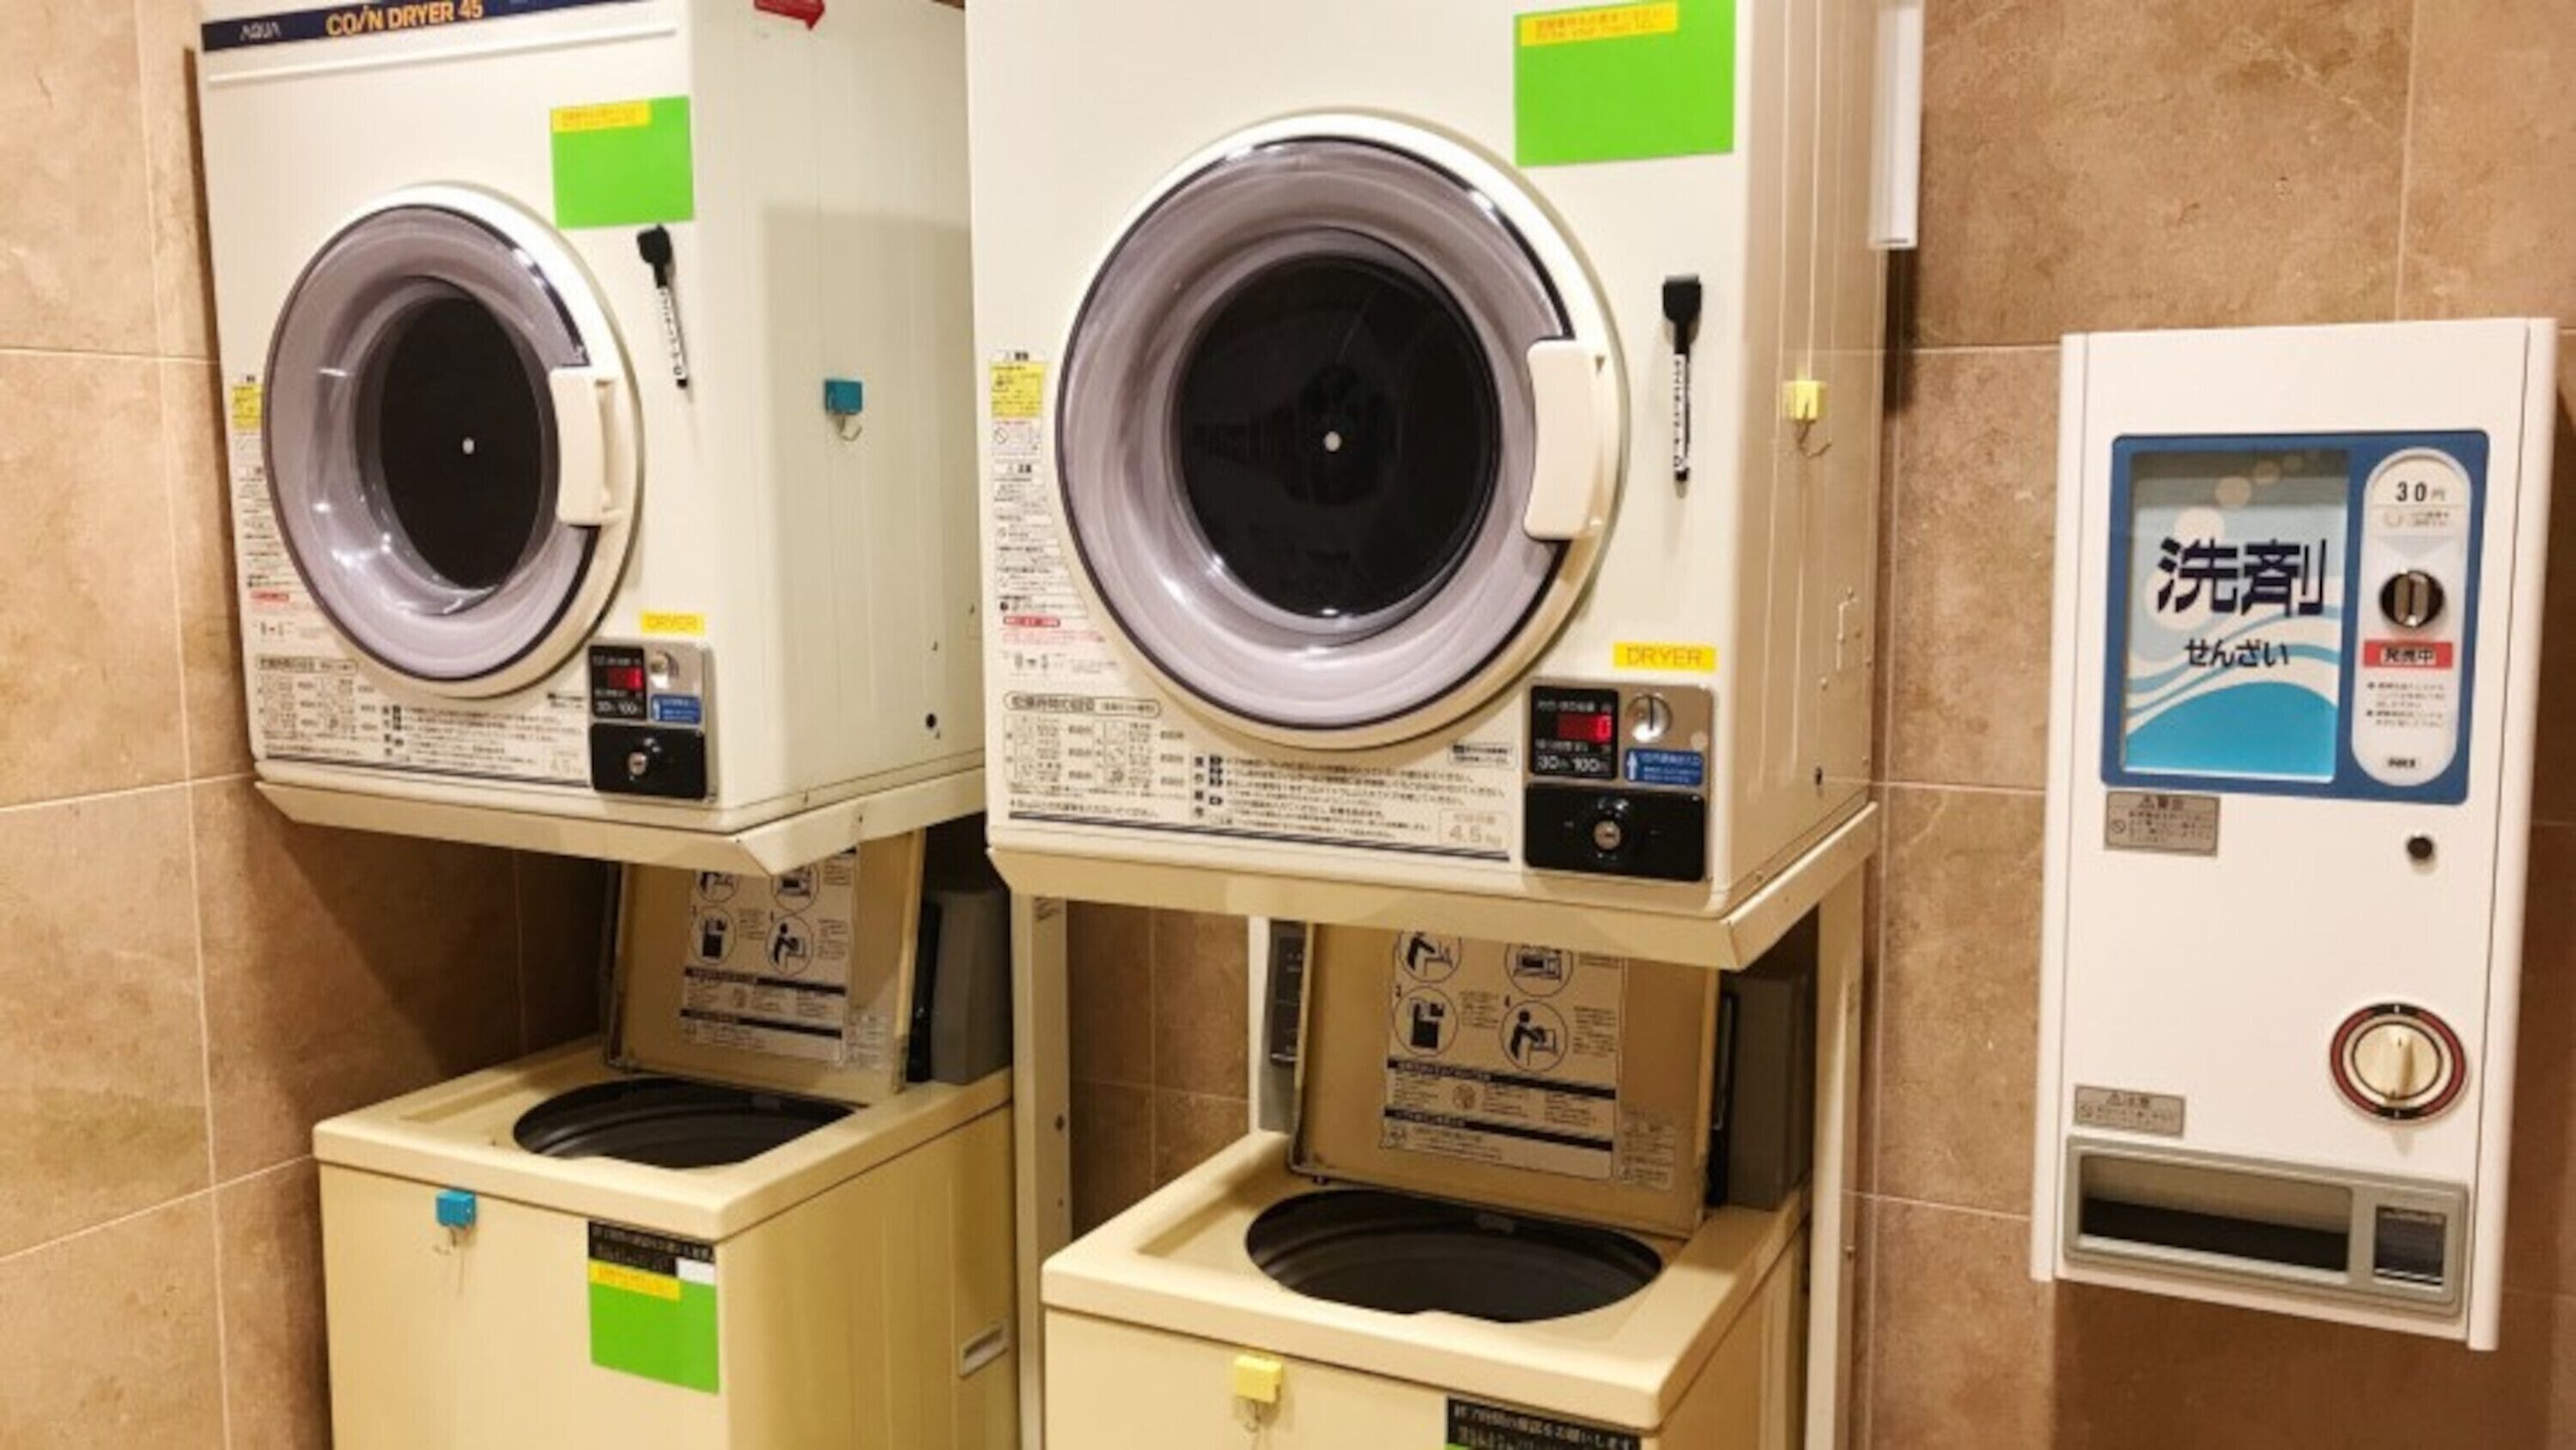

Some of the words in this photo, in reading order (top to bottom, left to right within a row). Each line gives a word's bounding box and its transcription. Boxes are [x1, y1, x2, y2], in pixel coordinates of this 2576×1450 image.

[387, 1, 454, 29] DRYER
[458, 0, 483, 19] 45
[240, 21, 282, 41] AQUA
[2156, 537, 2327, 617] 洗剤
[1626, 646, 1702, 667] DRYER
[2184, 640, 2289, 669] せんざい
[2383, 647, 2434, 663] 発売中
